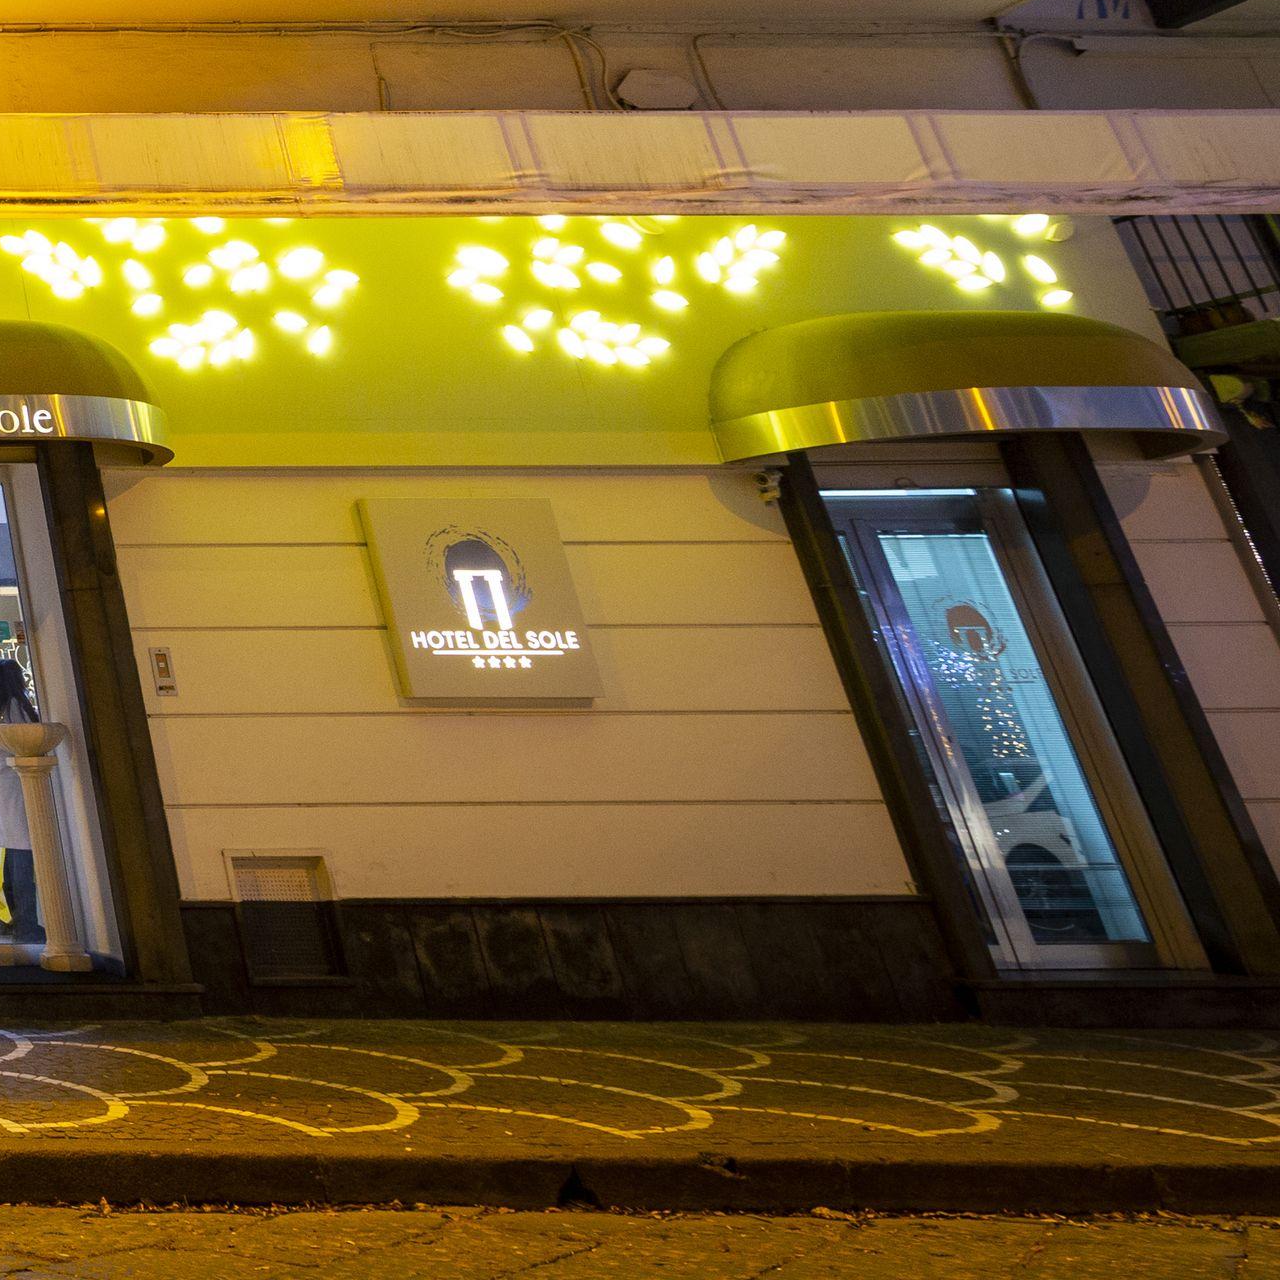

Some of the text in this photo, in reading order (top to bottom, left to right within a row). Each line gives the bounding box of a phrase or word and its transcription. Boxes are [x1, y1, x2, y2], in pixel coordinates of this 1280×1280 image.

[410, 630, 580, 650] HOTEL DEL SOLE
